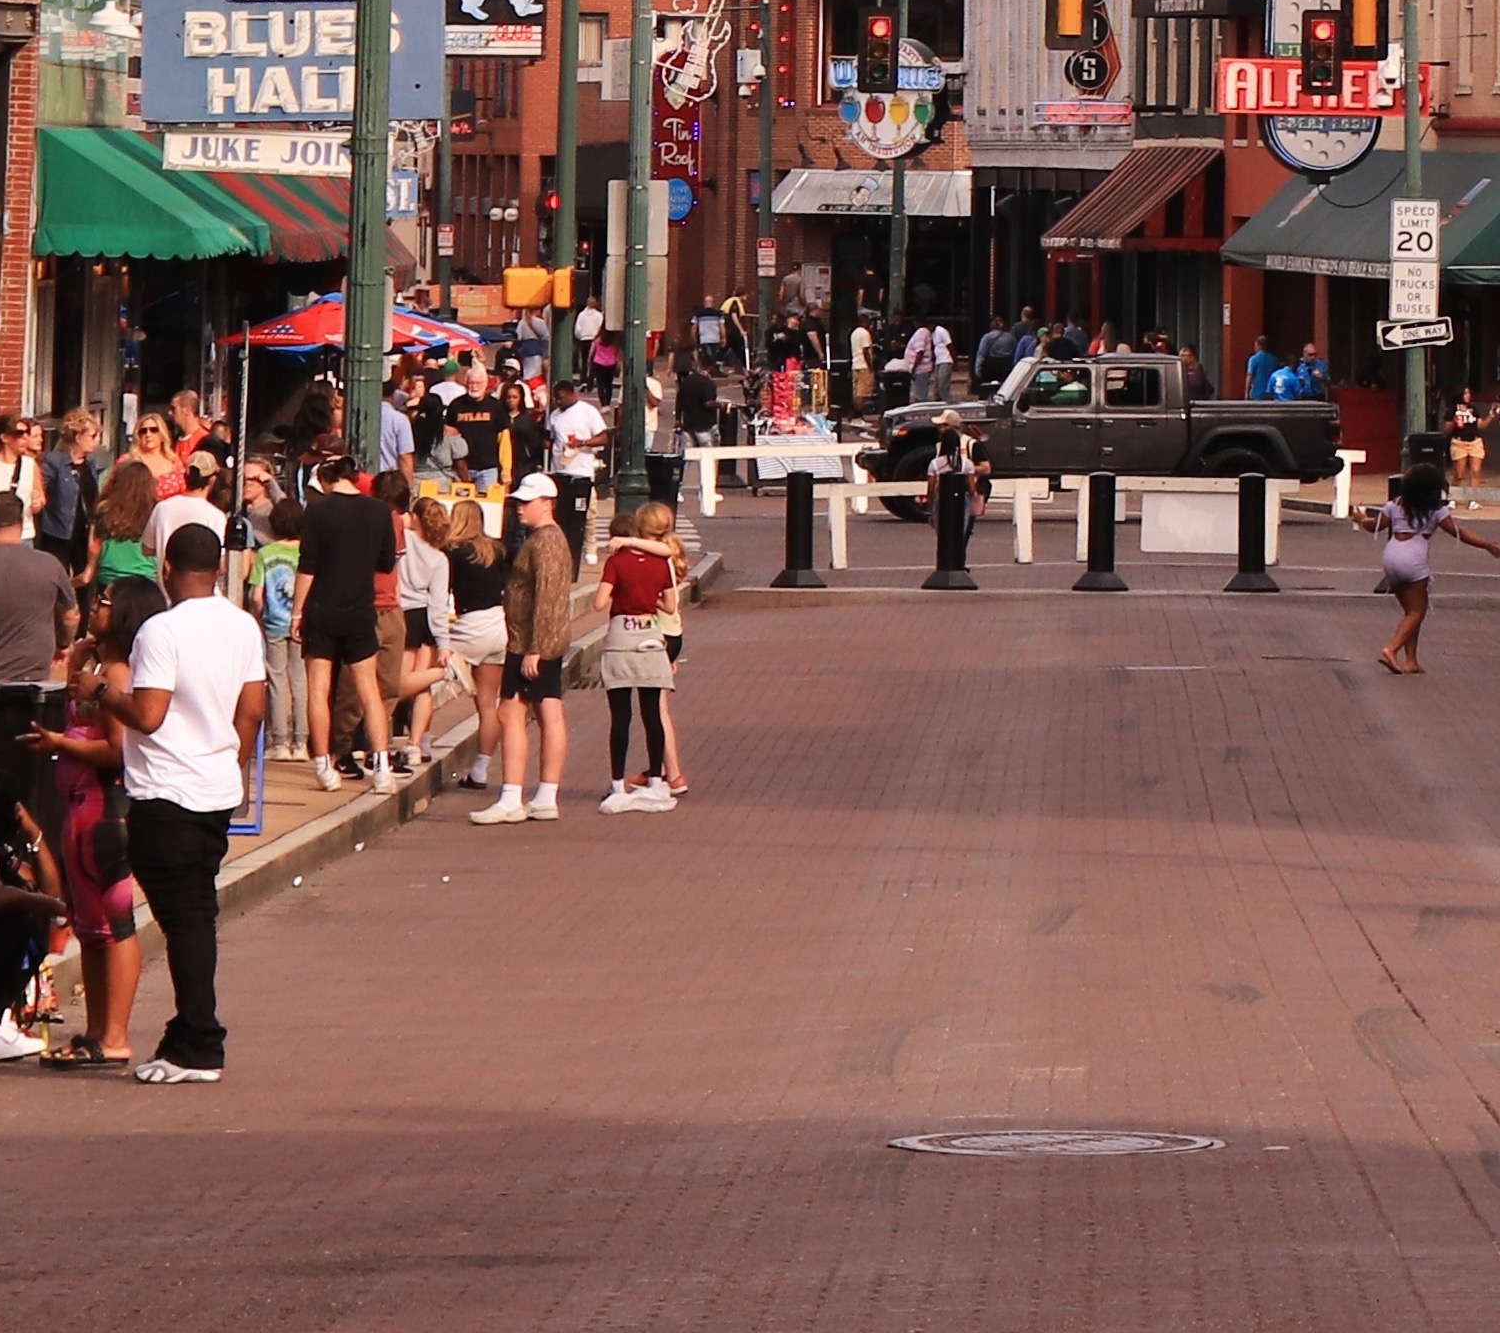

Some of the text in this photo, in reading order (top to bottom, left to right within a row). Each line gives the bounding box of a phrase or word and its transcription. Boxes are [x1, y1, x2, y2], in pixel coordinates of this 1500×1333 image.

[662, 117, 692, 141] Tin
[182, 136, 260, 162] JUKE
[657, 142, 695, 176] Roof
[1396, 206, 1434, 216] SPEED
[1400, 219, 1430, 229] LIMIT
[1397, 231, 1433, 252] 20
[1407, 267, 1423, 277] NO
[1394, 279, 1436, 290] TRUCKS
[1407, 292, 1422, 302] OR
[1396, 303, 1432, 314] BUSES
[1402, 325, 1445, 339] ONE WAY
